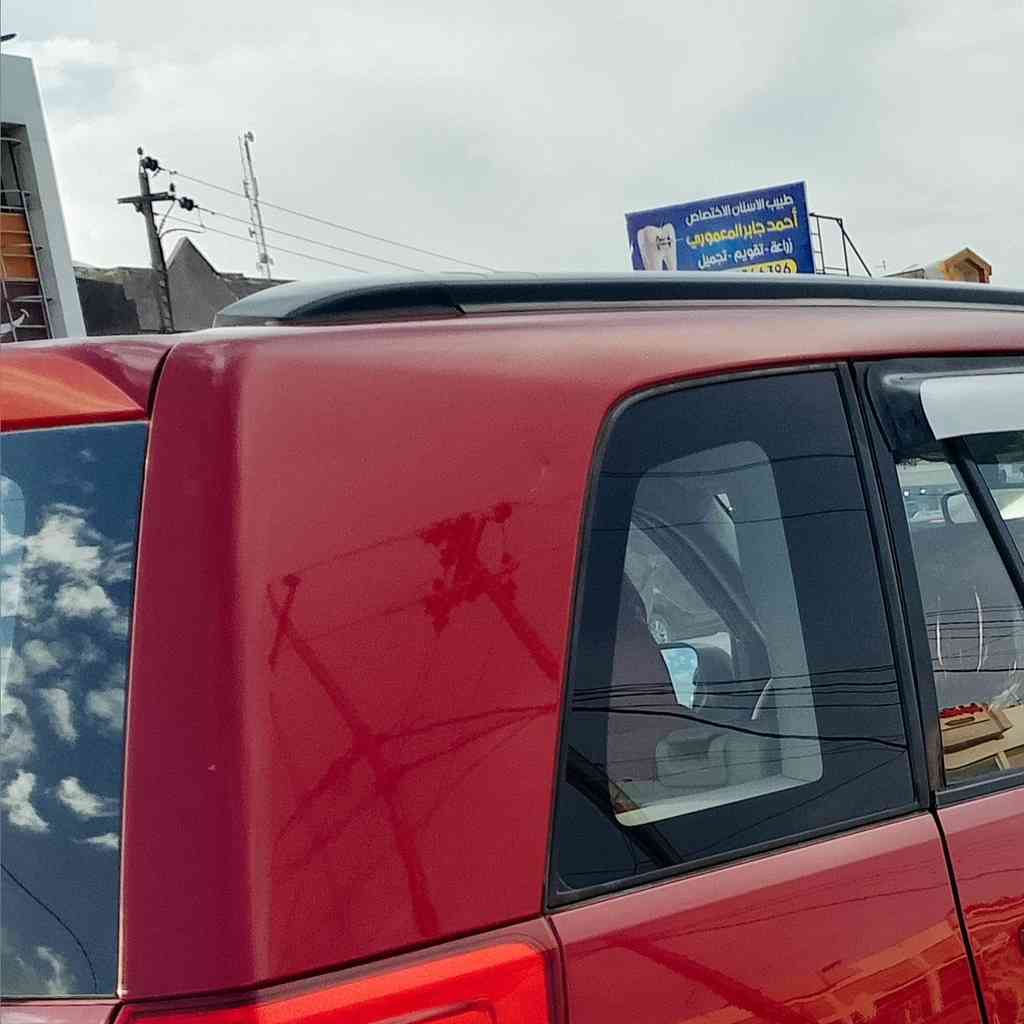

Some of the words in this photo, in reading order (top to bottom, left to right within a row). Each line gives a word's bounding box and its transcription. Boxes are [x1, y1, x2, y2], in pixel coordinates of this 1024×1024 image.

[766, 194, 793, 209] طبيب
[767, 208, 798, 232] أحمد
[698, 250, 727, 269] تجميل
[733, 243, 764, 263] تقويم
